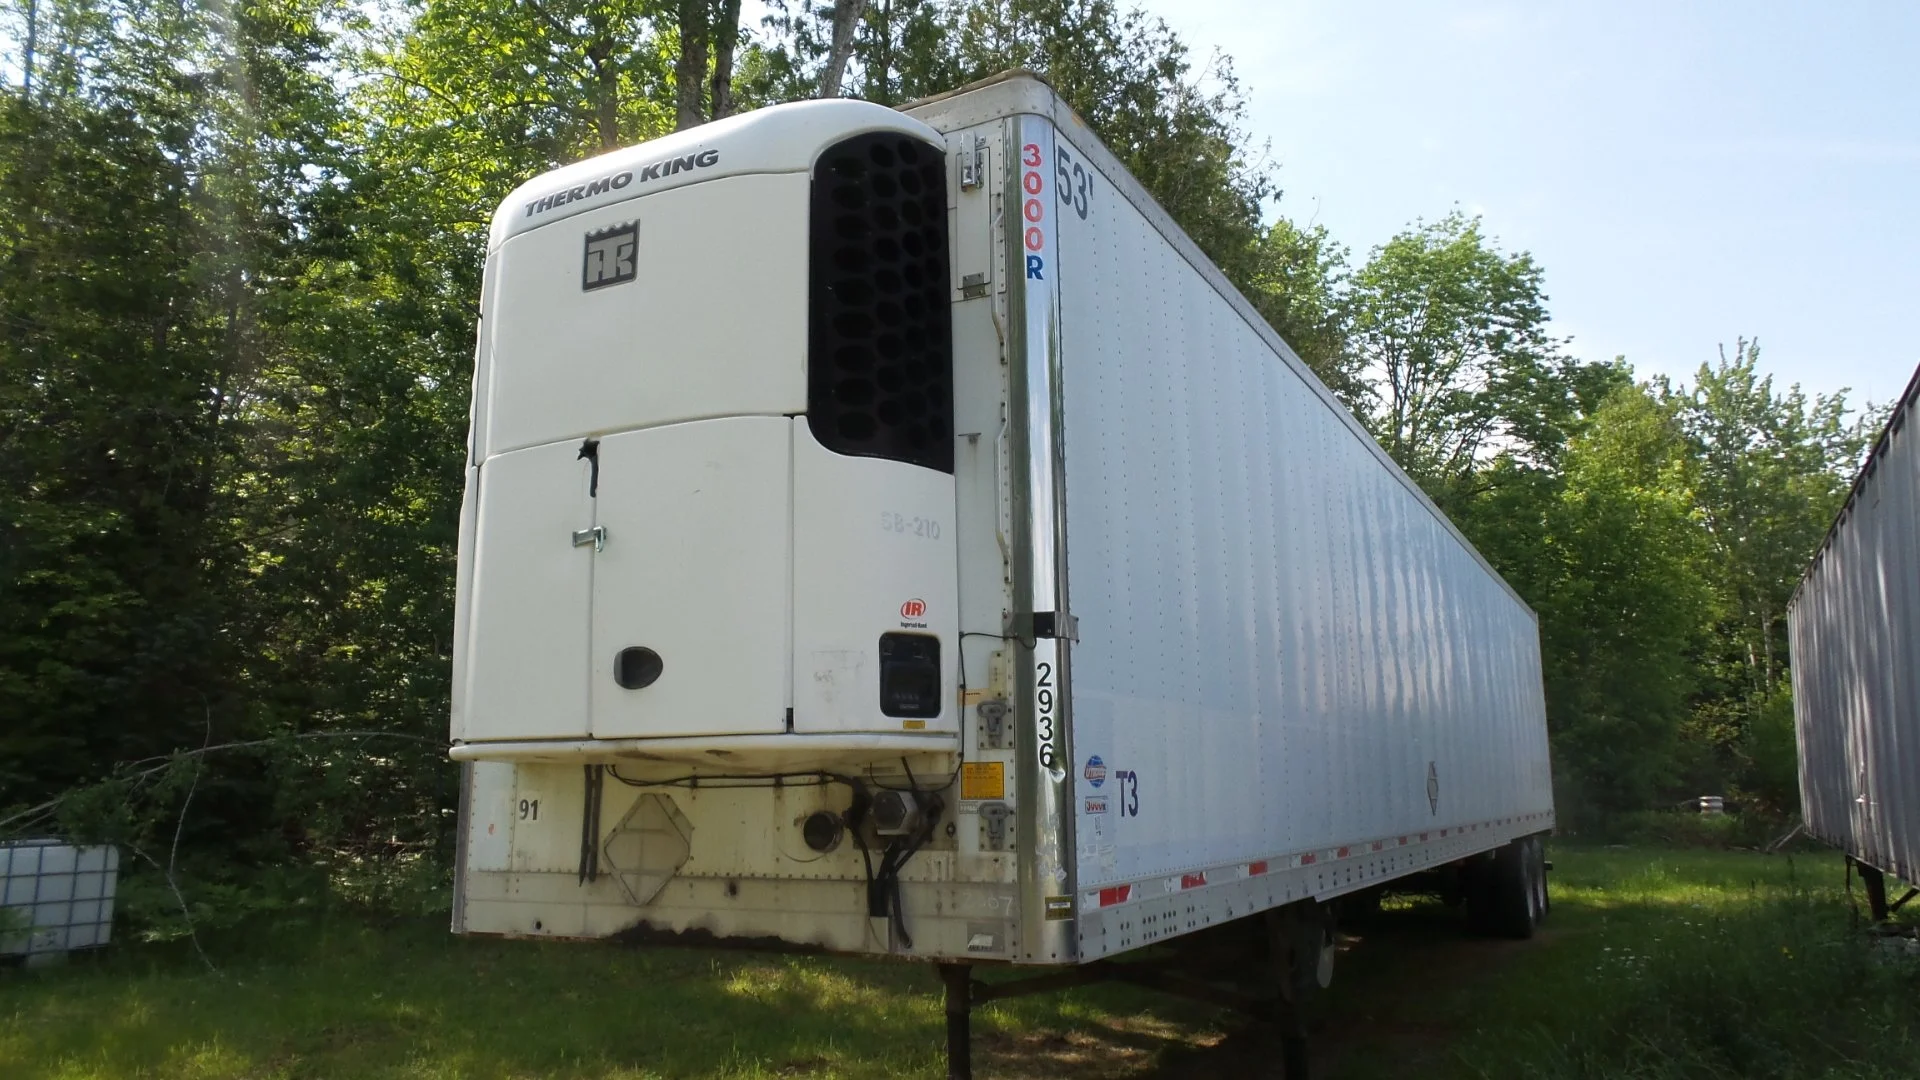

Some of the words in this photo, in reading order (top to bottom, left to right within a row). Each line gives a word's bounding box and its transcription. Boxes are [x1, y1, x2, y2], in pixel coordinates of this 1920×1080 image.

[525, 171, 633, 217] THERMO
[640, 150, 719, 182] KING
[1023, 143, 1043, 280] 3000R
[905, 601, 922, 616] IR
[1037, 662, 1053, 768] 2936
[519, 799, 539, 821] 91
[1115, 770, 1138, 817] T3
